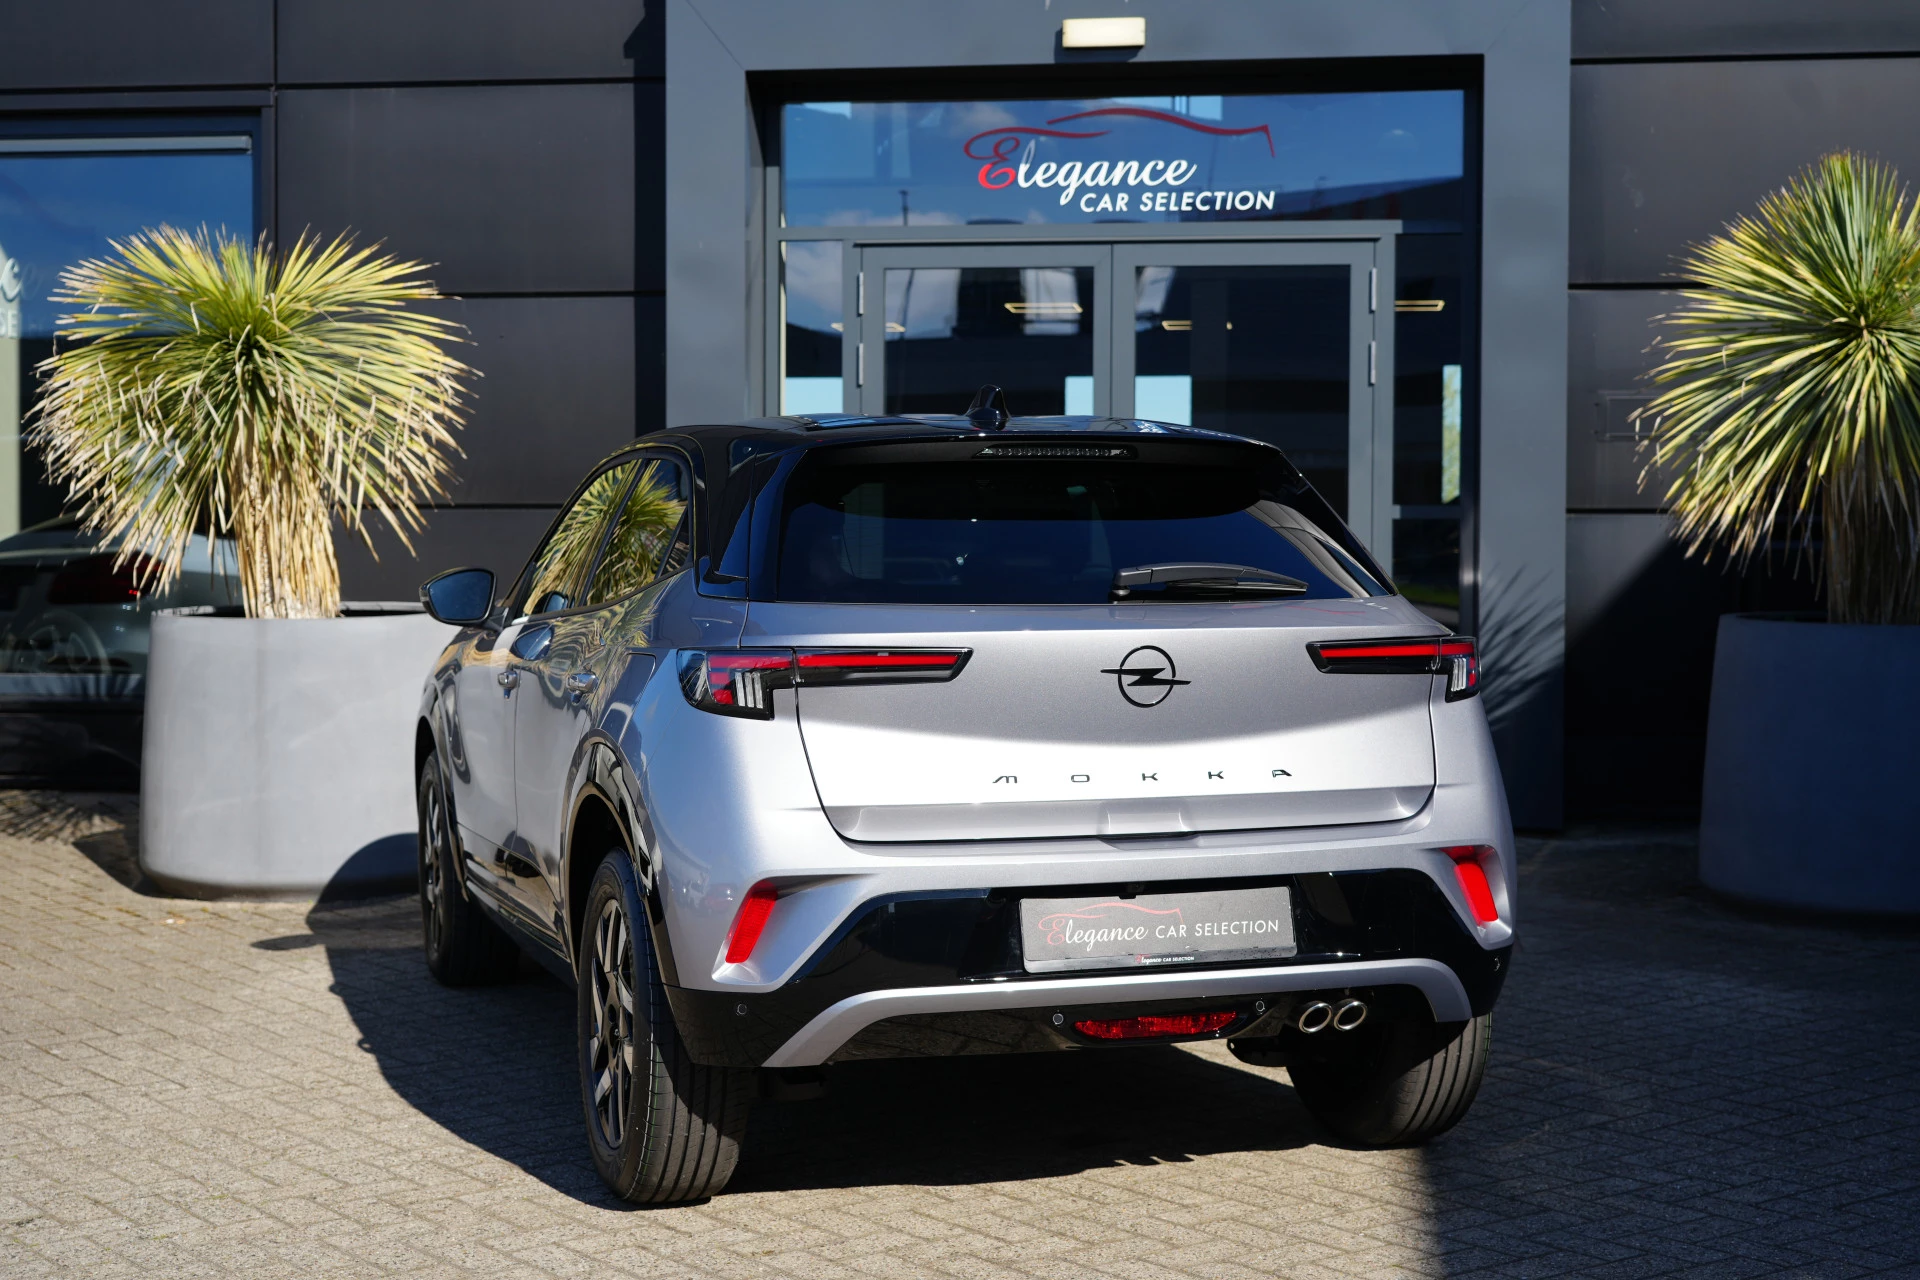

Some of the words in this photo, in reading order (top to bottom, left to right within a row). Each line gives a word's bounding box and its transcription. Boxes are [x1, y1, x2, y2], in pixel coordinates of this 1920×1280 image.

[968, 135, 1197, 206] Elegance
[1079, 191, 1129, 213] CAR
[1139, 190, 1276, 213] SELECTION
[992, 768, 1293, 784] MOKKA
[1042, 917, 1149, 952] Elegance
[1155, 923, 1188, 939] CAR
[1194, 918, 1280, 938] SELECTION
